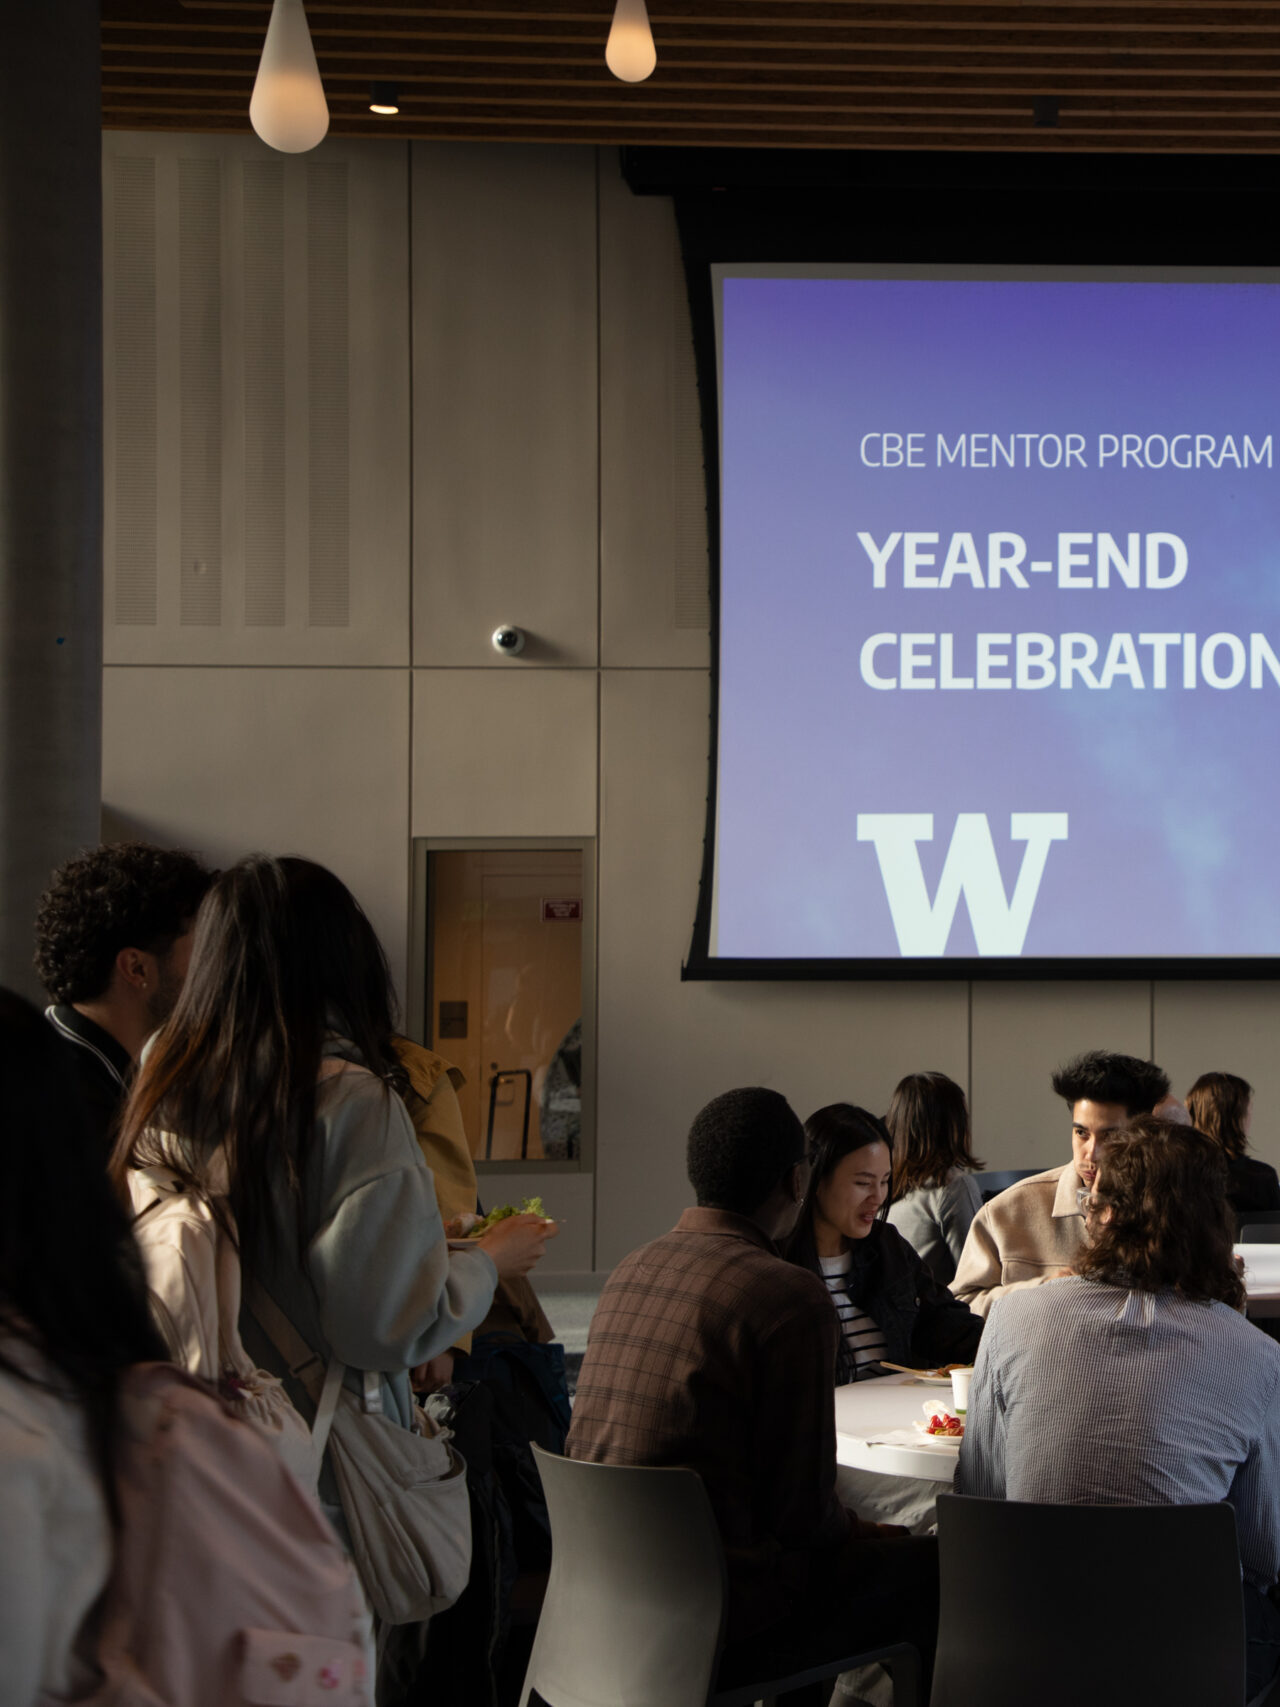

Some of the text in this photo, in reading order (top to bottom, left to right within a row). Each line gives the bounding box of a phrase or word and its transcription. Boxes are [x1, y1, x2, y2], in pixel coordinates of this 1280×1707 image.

[860, 432, 1273, 468] CBE MENTOR PROGRAM
[857, 532, 1188, 589] YEAR-END
[857, 812, 1068, 956] W
